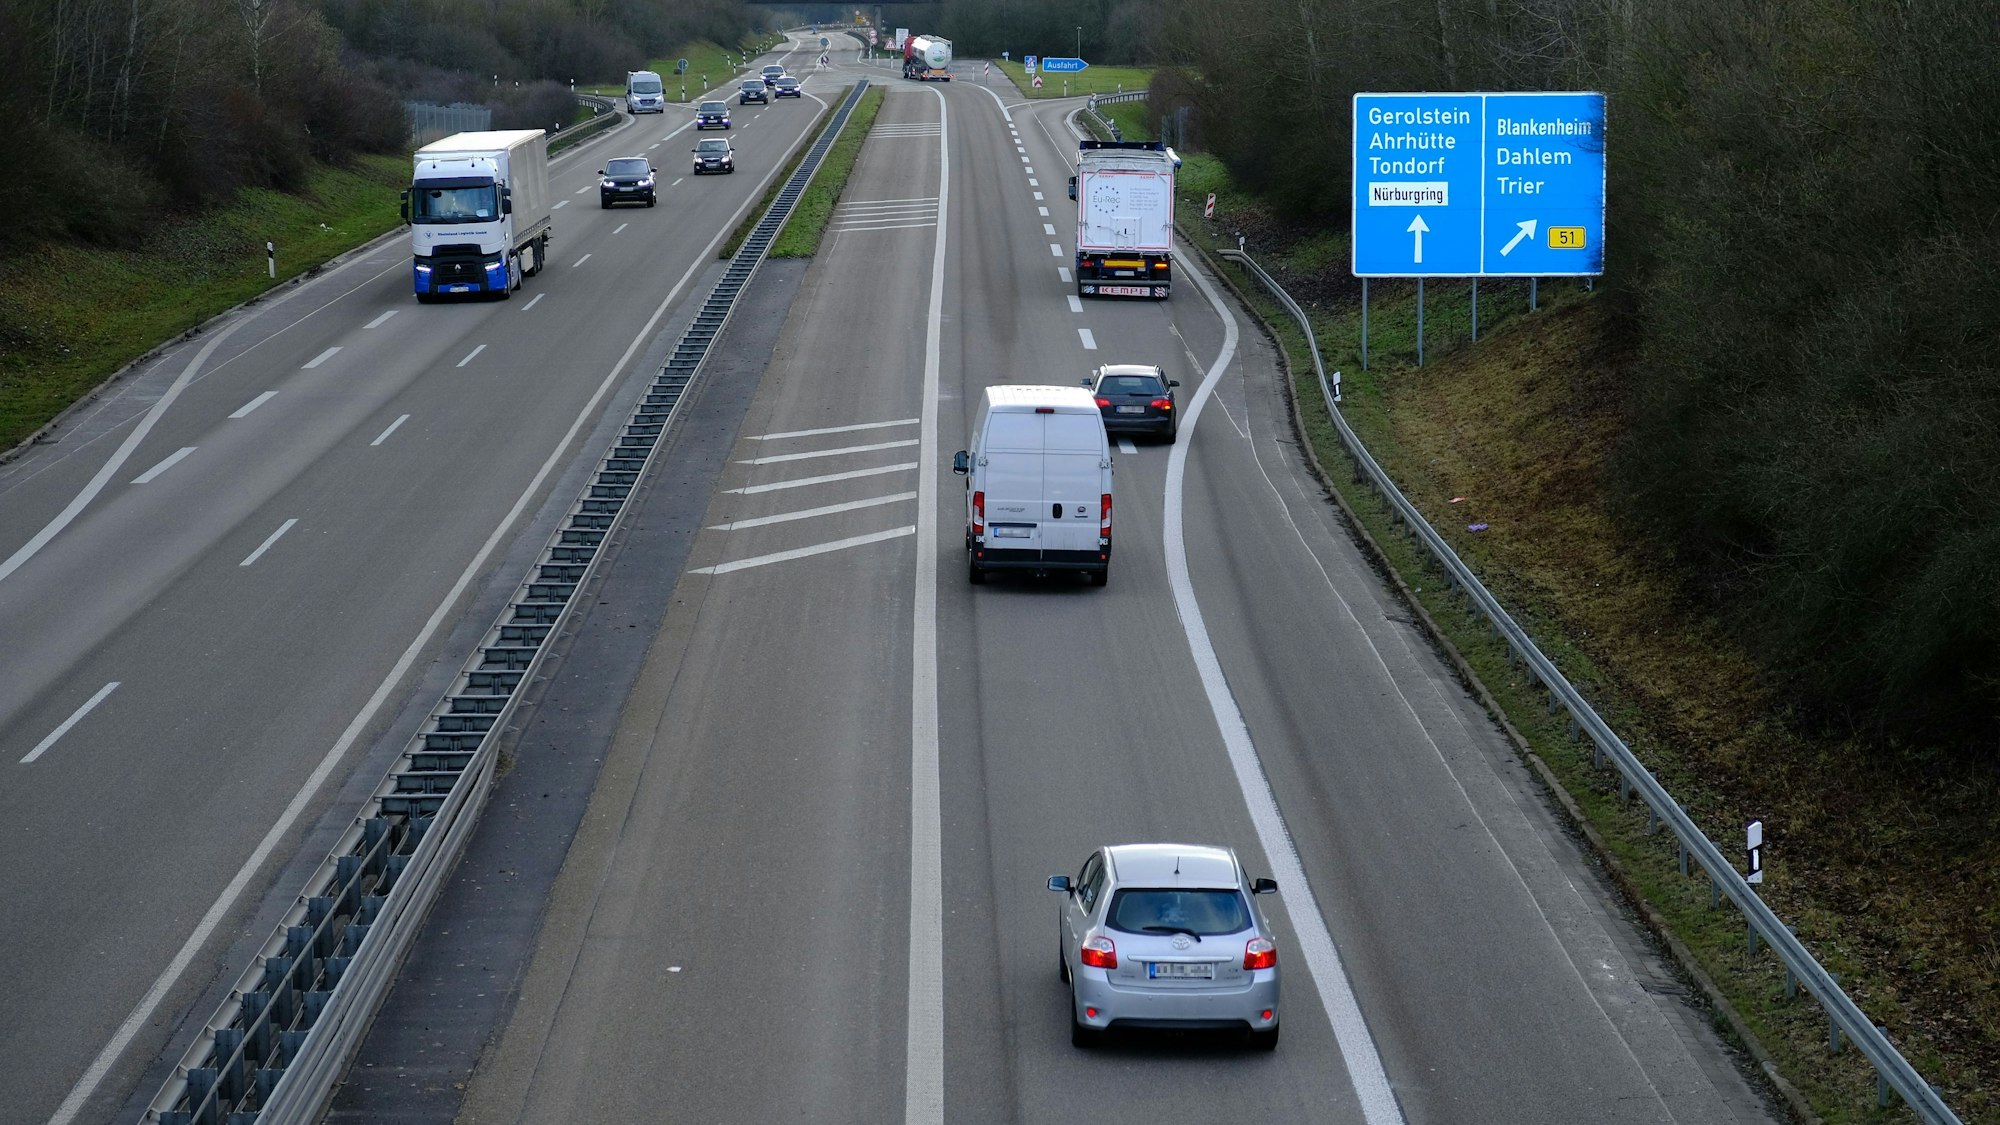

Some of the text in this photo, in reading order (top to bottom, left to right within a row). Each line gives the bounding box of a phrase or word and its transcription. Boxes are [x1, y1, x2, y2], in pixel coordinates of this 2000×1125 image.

[1047, 61, 1078, 69] Ausfahrt
[1368, 107, 1470, 125] Gerolstein
[1497, 118, 1591, 136] Blankenheim
[1369, 132, 1456, 150] Ahrhütte
[1497, 148, 1572, 165] Dahlem
[1369, 157, 1445, 175] Tondorf
[1497, 177, 1545, 194] Trier
[1093, 195, 1121, 204] Eu-Rec
[1374, 187, 1443, 204] Nürburgring
[1560, 231, 1575, 245] 51
[1101, 287, 1148, 295] KEMPF
